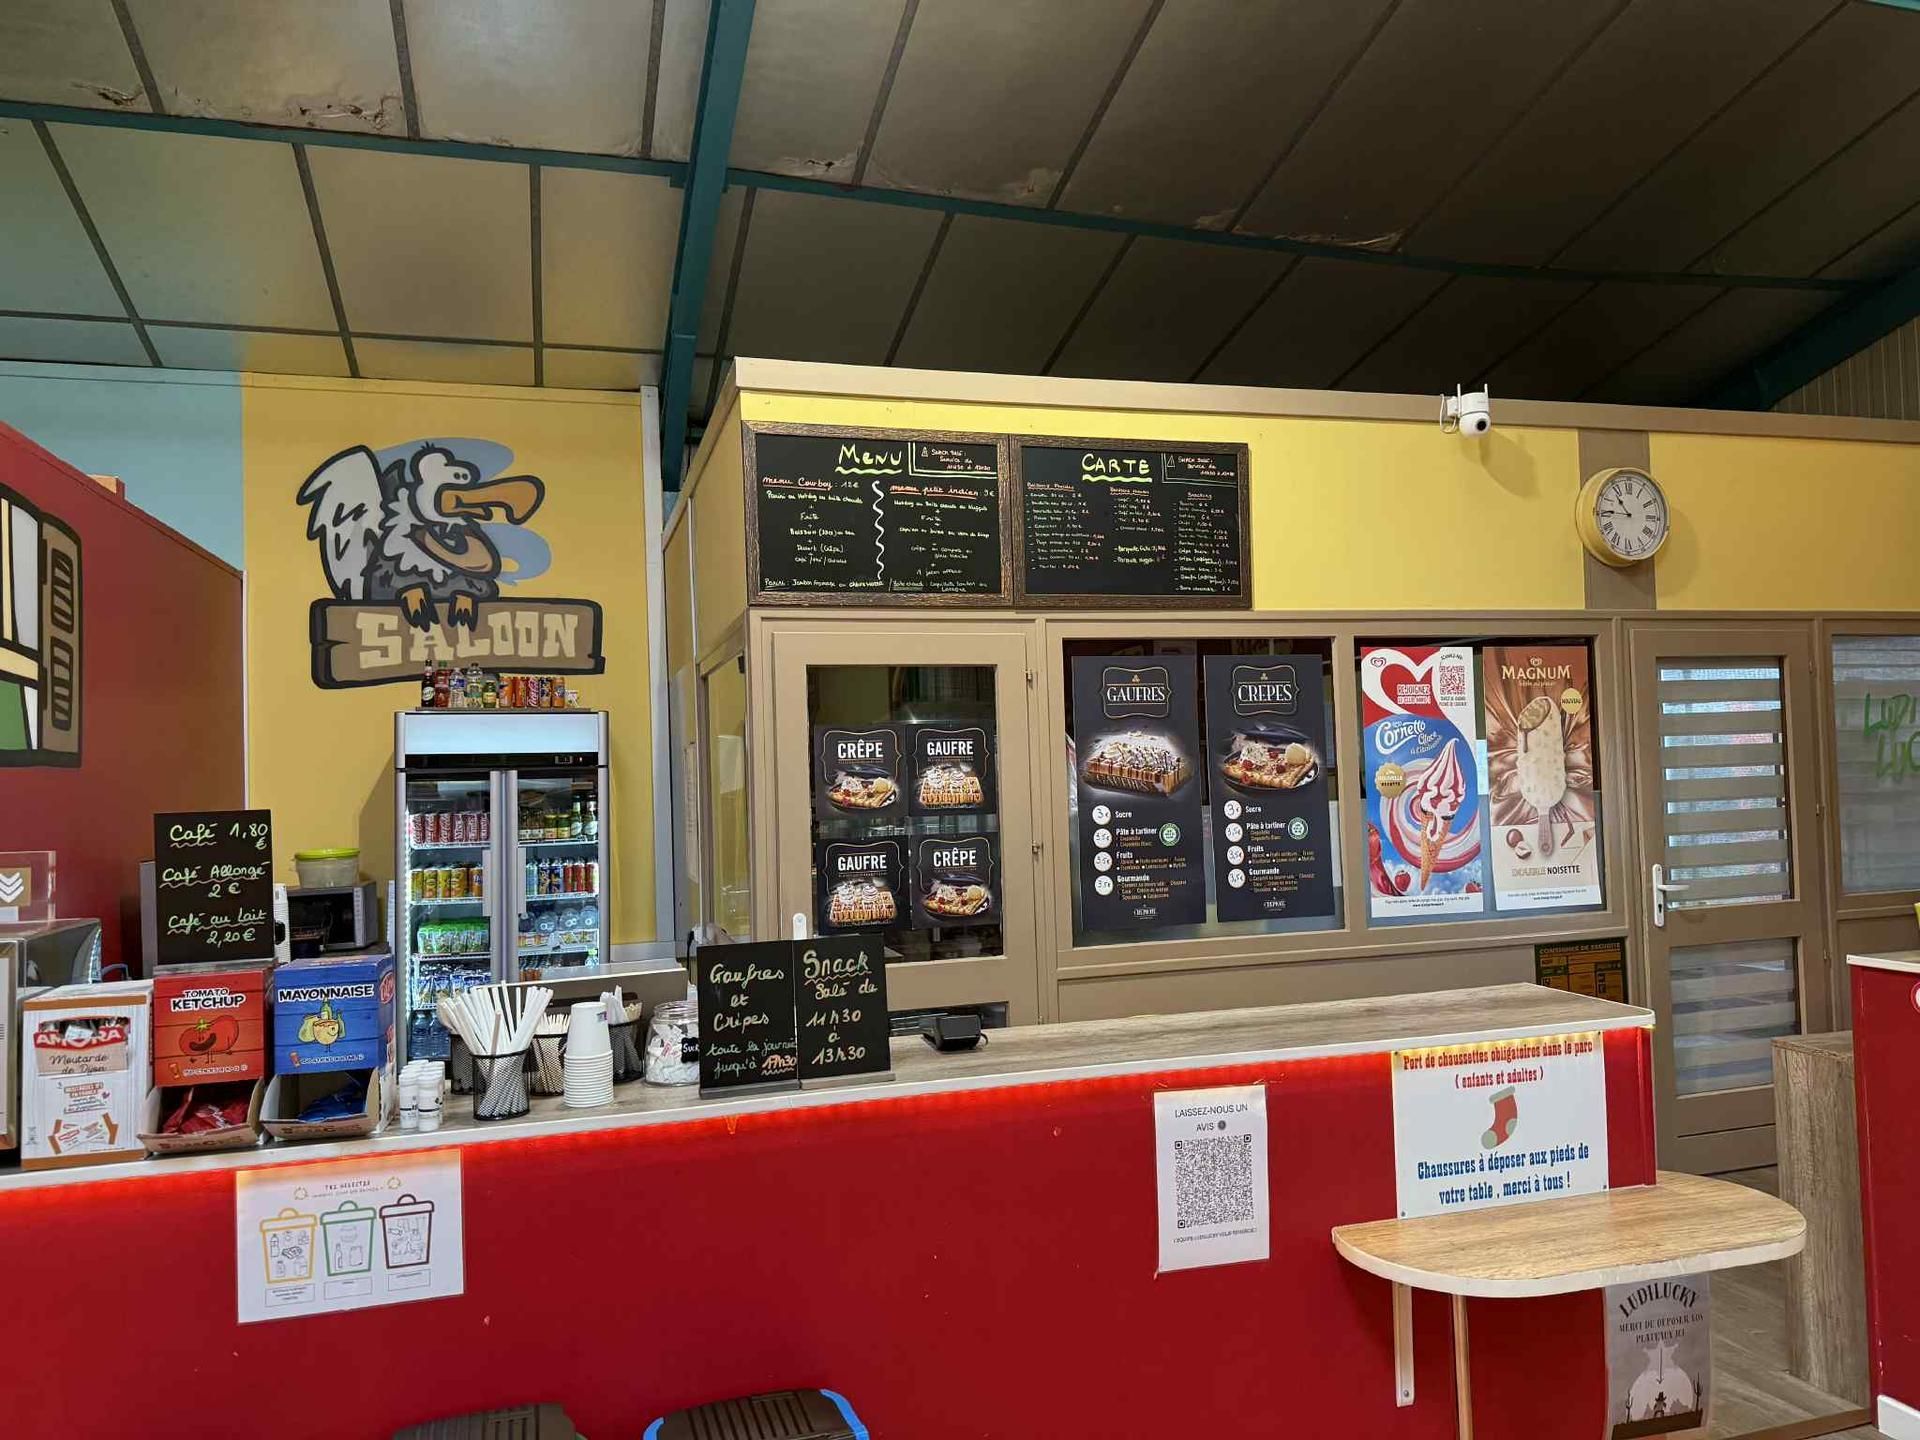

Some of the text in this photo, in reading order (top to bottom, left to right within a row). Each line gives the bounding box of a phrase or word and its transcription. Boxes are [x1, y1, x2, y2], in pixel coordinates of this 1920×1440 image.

[1501, 664, 1572, 680] MAGNUM
[1106, 686, 1166, 703] GAUFRES
[1375, 719, 1426, 755] Cornetto
[837, 739, 884, 759] CRÊPE
[926, 741, 974, 757] GAUFRE
[169, 822, 269, 846] Café 1,80
[837, 855, 887, 872] GAUFRE
[933, 848, 977, 868] CRÊPE
[162, 861, 271, 885] Café Allongé
[1547, 865, 1581, 875] NOISETTE
[208, 882, 241, 899] 2 €
[168, 912, 207, 935] Café
[210, 917, 231, 925] au
[802, 949, 869, 979] Snack
[709, 963, 785, 989] Gaufres
[185, 987, 230, 999] TOMATO
[278, 985, 375, 1002] MAYONNAISE
[858, 979, 878, 995] de
[172, 996, 246, 1012] KETCHUP
[730, 993, 750, 1008] et
[805, 1009, 862, 1028] 11h30
[50, 1055, 109, 1067] Moutarde
[811, 1046, 867, 1066] 13h30
[1404, 1041, 1593, 1070] Port de chaussettes obligatoires dans le parc
[1462, 1071, 1494, 1089] enfants
[1496, 1071, 1505, 1085] et
[1507, 1066, 1538, 1084] adultes
[1196, 1121, 1215, 1132] AVIS
[1417, 1143, 1590, 1180] Chaussures à déposer aux pieds de
[1439, 1189, 1466, 1206] votre
[1468, 1182, 1494, 1202] table
[1503, 1179, 1532, 1198] merci
[1534, 1174, 1541, 1192] à
[1543, 1174, 1565, 1191] tous
[1618, 1282, 1700, 1318] LUDILUCKY
[1619, 1322, 1642, 1332] MERCI
